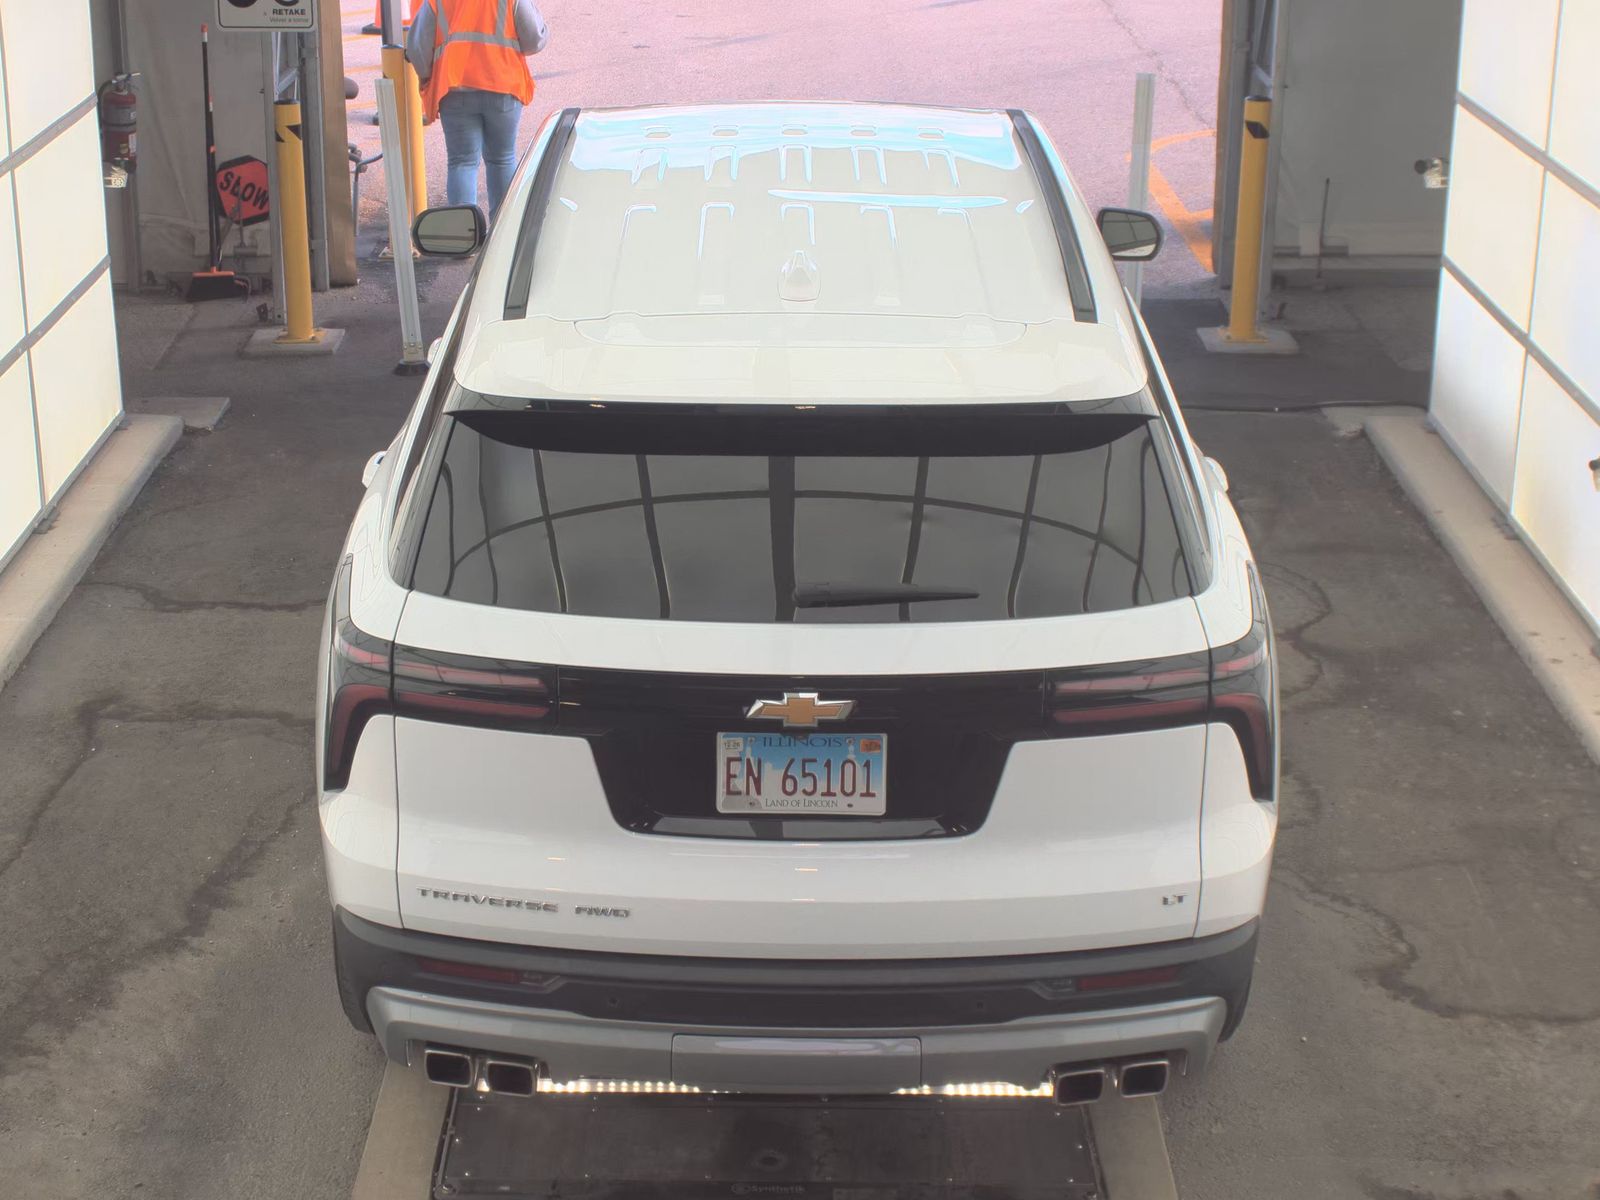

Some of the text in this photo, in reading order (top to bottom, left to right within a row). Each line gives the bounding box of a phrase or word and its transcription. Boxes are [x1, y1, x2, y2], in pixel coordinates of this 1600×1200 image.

[272, 8, 306, 16] RETAKE
[219, 170, 269, 210] SLOW
[762, 735, 843, 748] ILLINOIS
[725, 756, 877, 798] EN 65101
[765, 798, 838, 808] LAND OF LINCOLN
[416, 886, 631, 918] TRAVERSE AWD
[1161, 893, 1189, 906] LT
